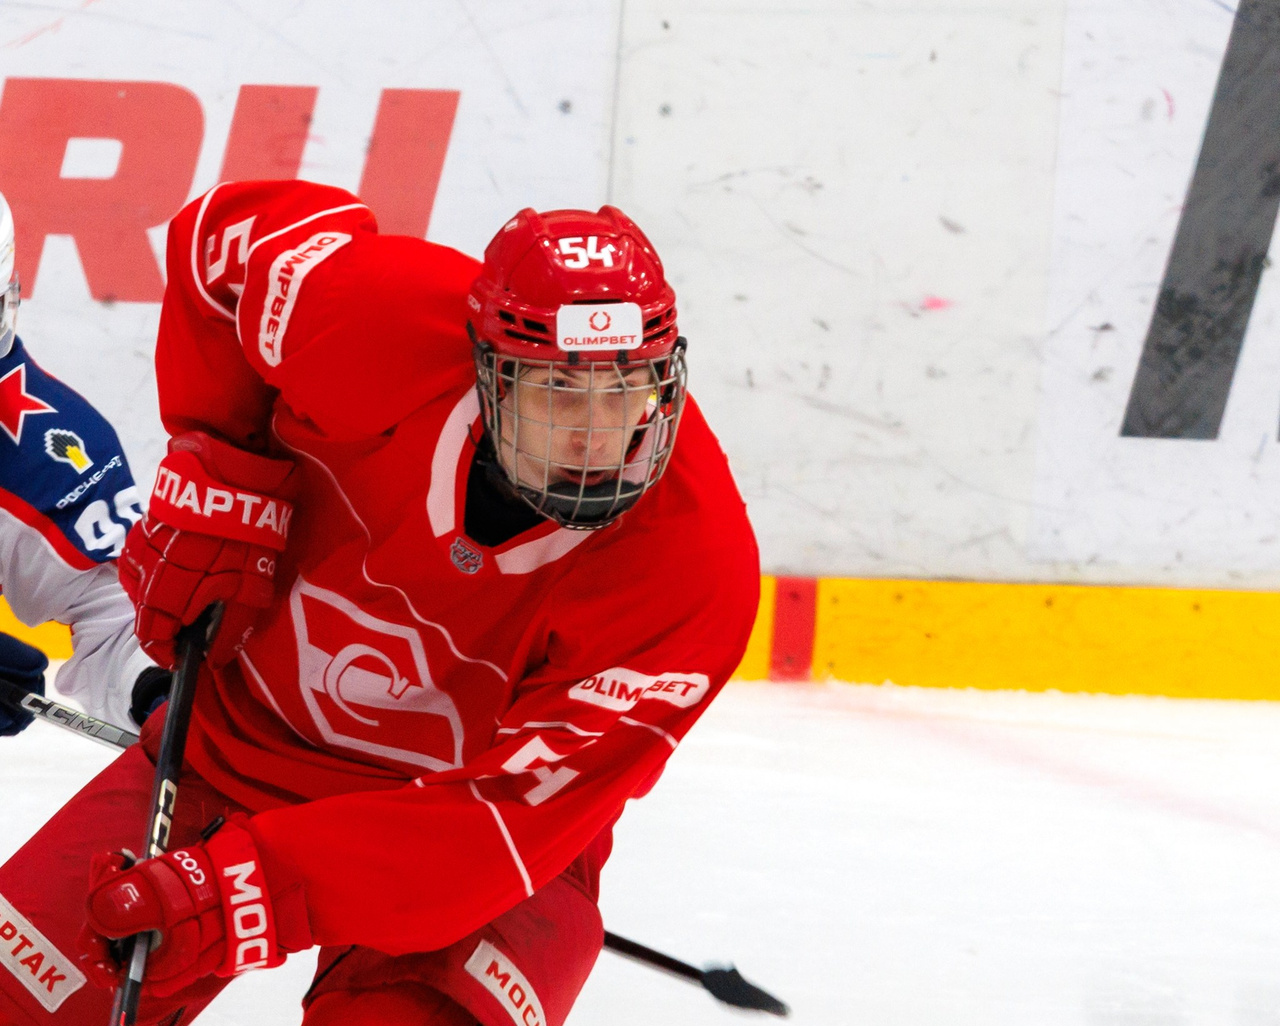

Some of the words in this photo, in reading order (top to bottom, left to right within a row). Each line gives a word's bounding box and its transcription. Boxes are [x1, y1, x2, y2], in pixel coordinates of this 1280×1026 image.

[558, 236, 615, 269] 54
[265, 236, 338, 358] OLIMPBET
[563, 335, 637, 346] OLIMPBET
[580, 675, 698, 702] OLIMBET
[20, 692, 104, 738] CCM
